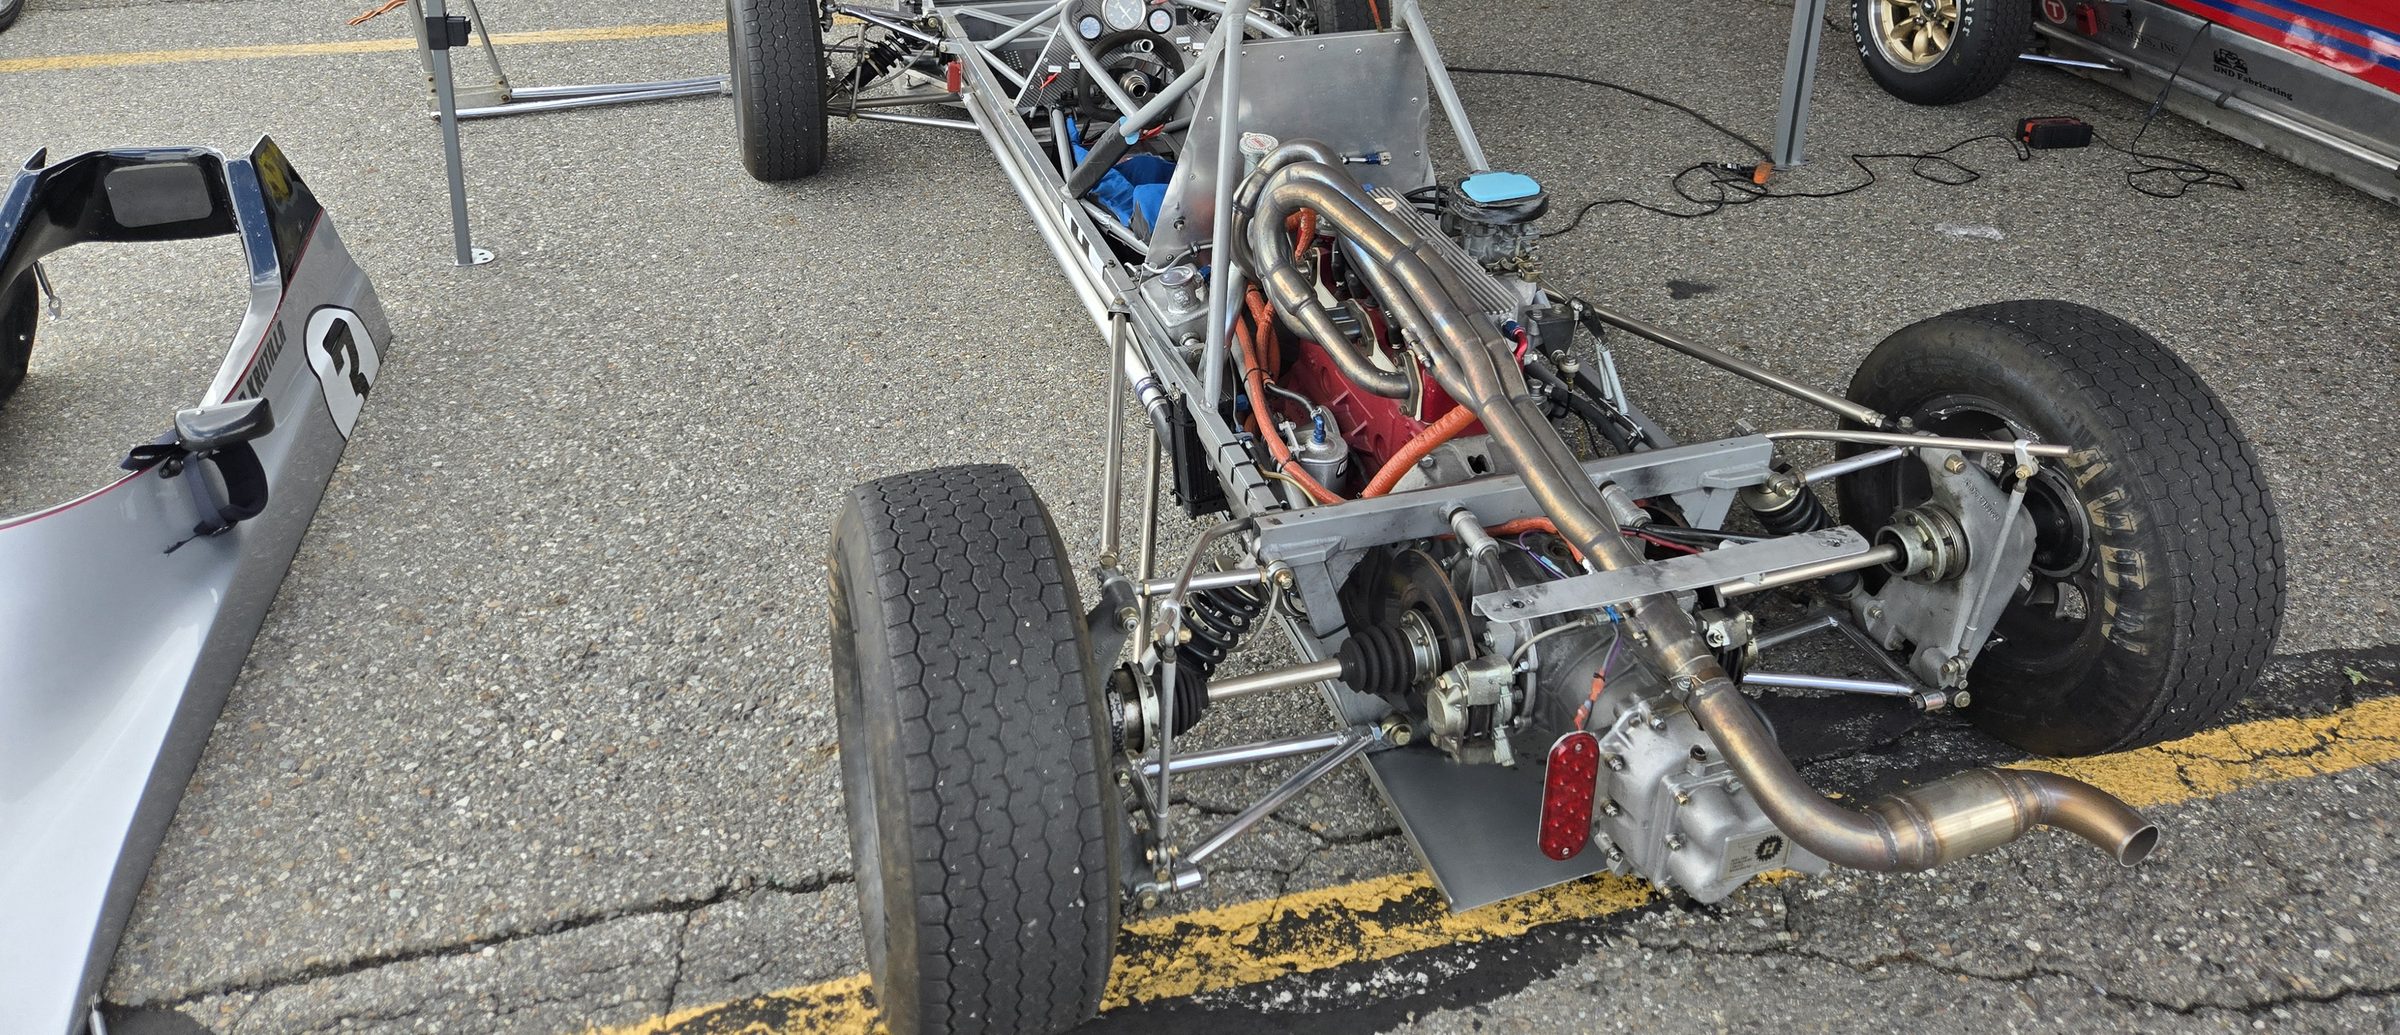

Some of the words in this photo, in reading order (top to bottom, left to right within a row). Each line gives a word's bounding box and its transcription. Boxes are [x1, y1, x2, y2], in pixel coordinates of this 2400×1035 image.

[2213, 64, 2235, 78] DND
[2237, 73, 2293, 101] Fabricating
[246, 319, 287, 399] KRUTILLA
[2061, 447, 2149, 656] AVON
